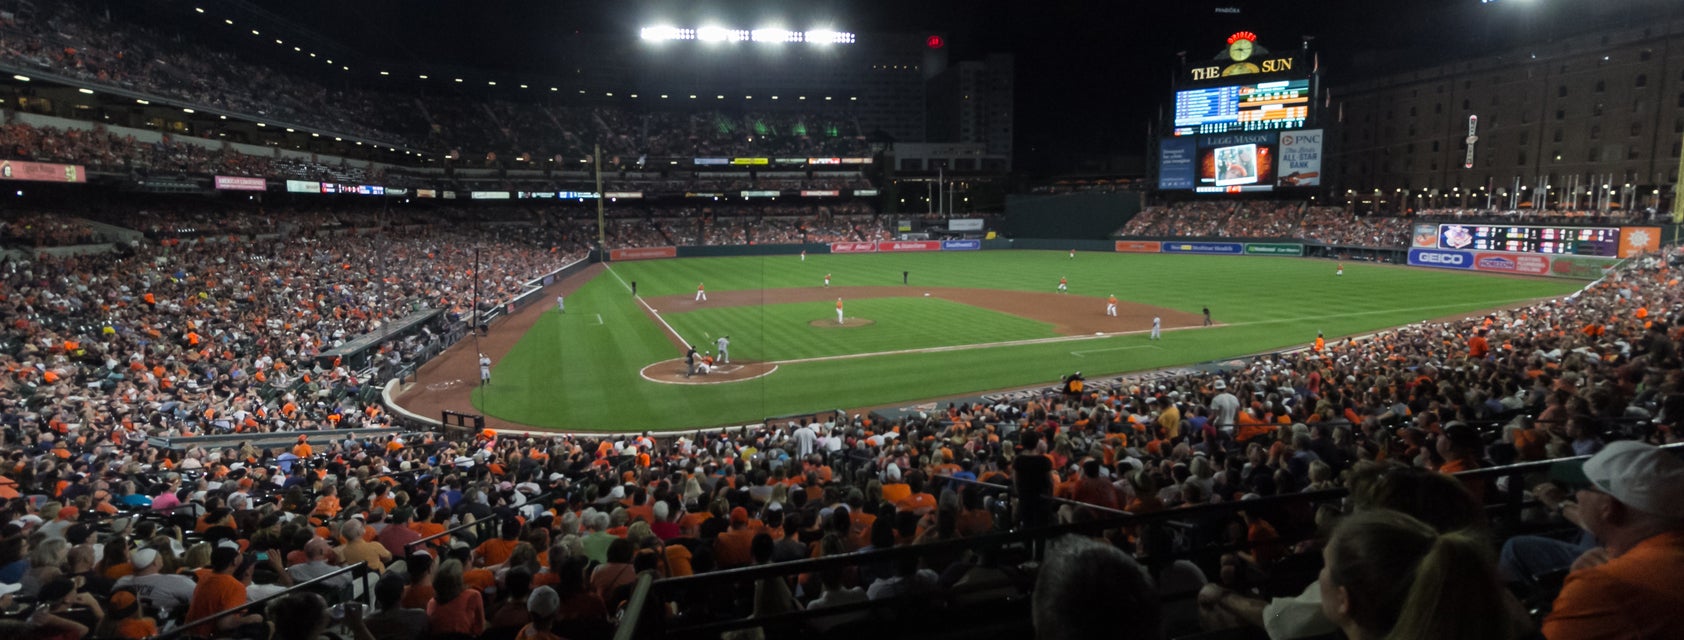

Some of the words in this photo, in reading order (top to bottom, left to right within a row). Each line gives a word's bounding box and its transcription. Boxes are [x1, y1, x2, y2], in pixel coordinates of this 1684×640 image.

[1227, 31, 1256, 44] ORIOLES
[1191, 66, 1220, 80] THE
[1262, 58, 1293, 73] SUN
[1207, 137, 1232, 145] LEGG
[1233, 135, 1267, 144] MASON
[1296, 135, 1320, 144] PNC
[1289, 161, 1309, 169] BANK
[1419, 253, 1463, 264] GEICO
[1479, 260, 1514, 269] HORIZON
